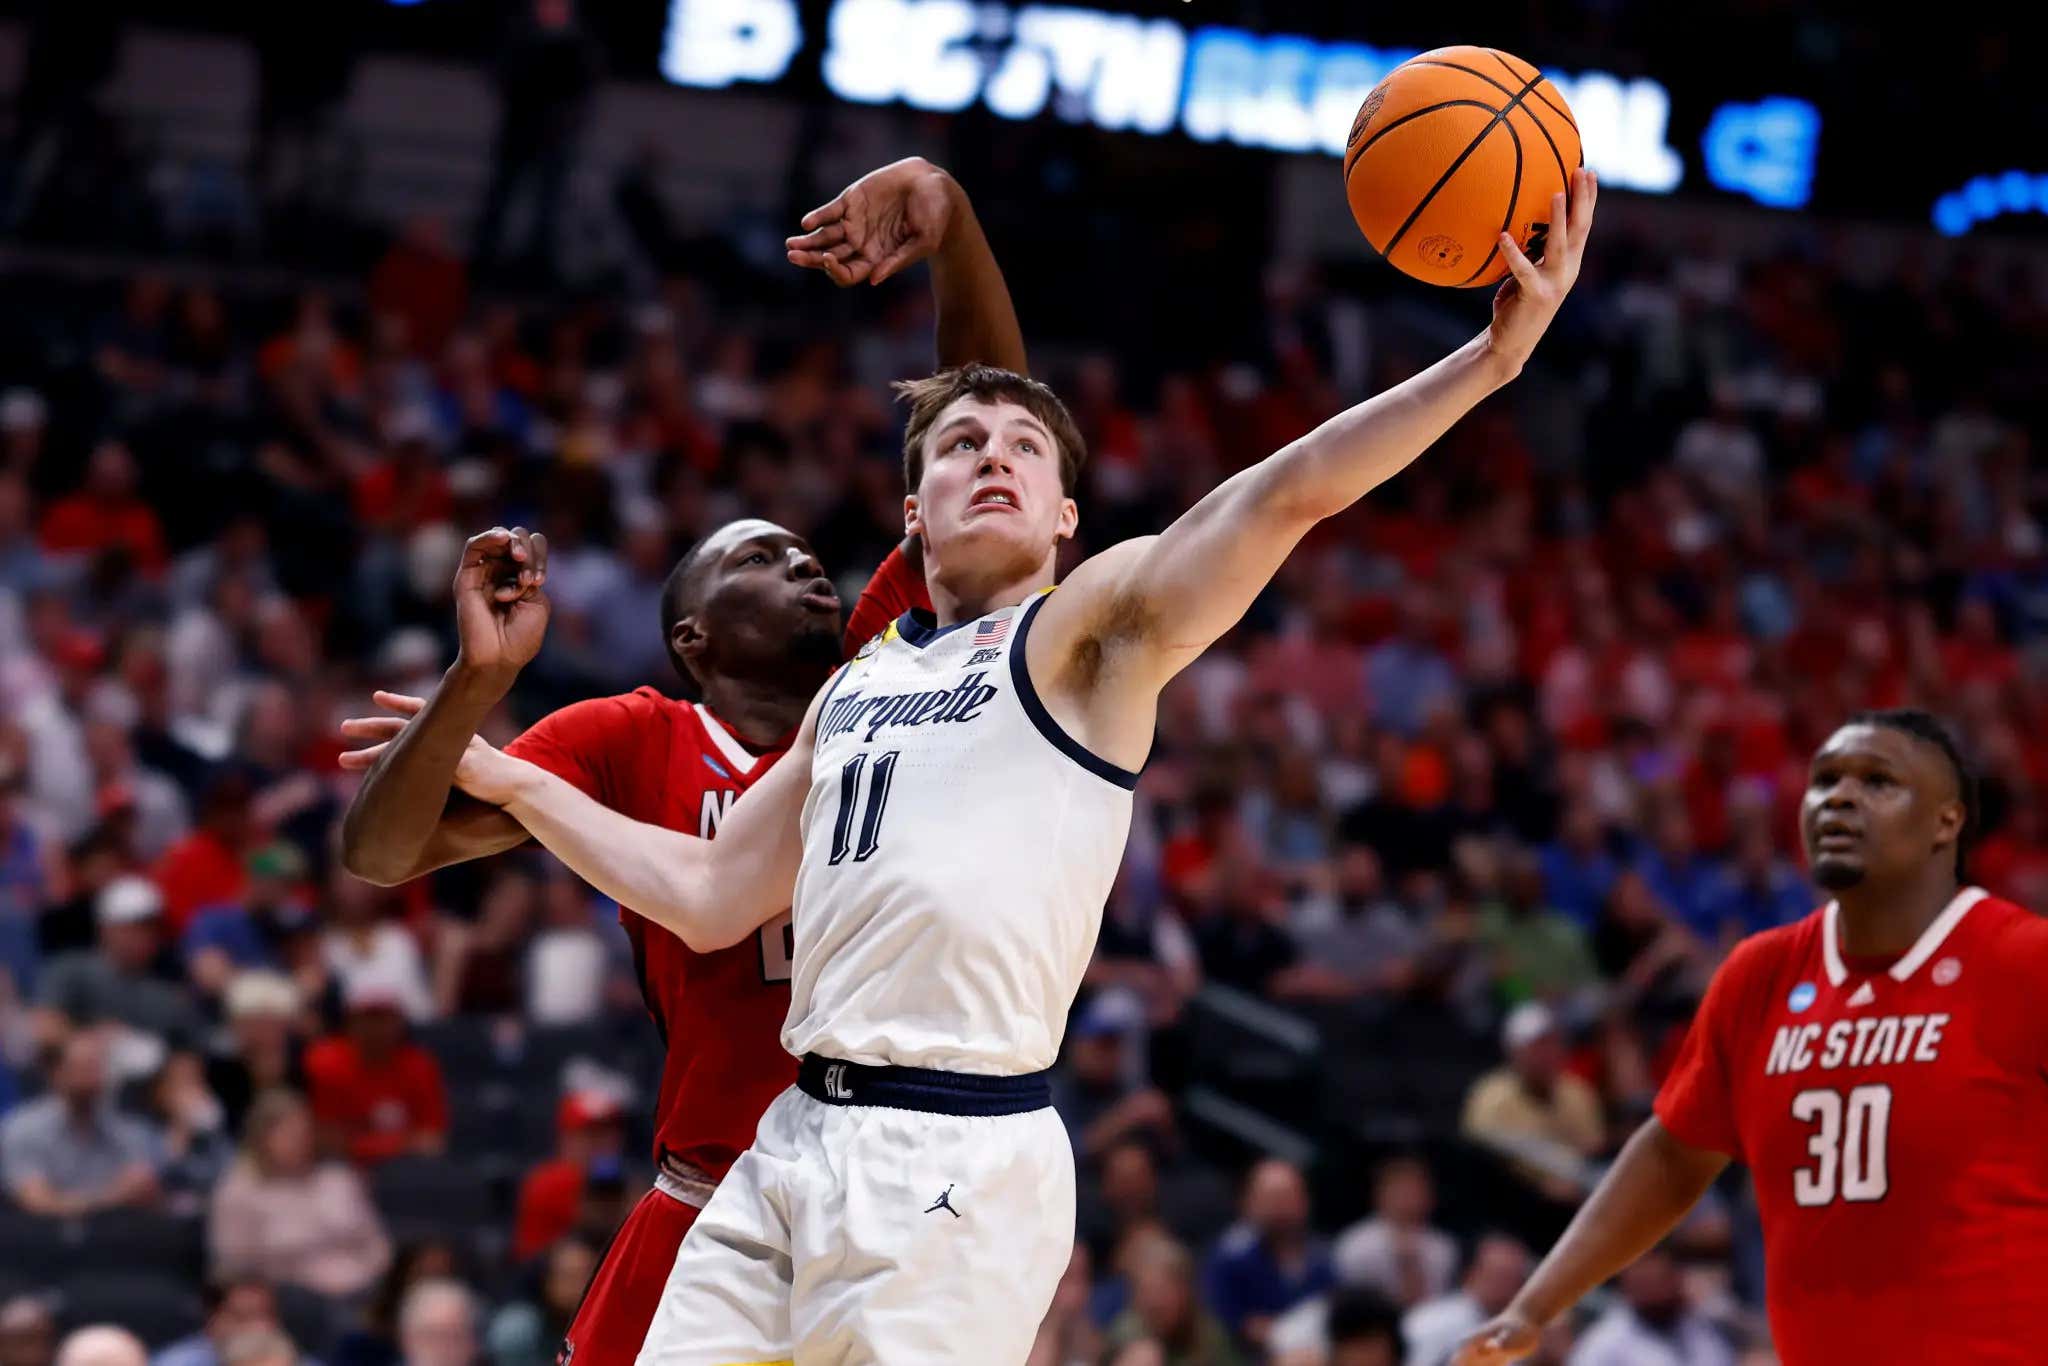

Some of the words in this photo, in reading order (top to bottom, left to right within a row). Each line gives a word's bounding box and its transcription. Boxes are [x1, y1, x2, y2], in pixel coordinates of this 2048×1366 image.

[823, 671, 998, 743] Marquette
[828, 751, 900, 866] 11
[1766, 1022, 1821, 1075] NC
[1820, 1013, 1949, 1069] STATE
[1792, 1083, 1892, 1207] 30
